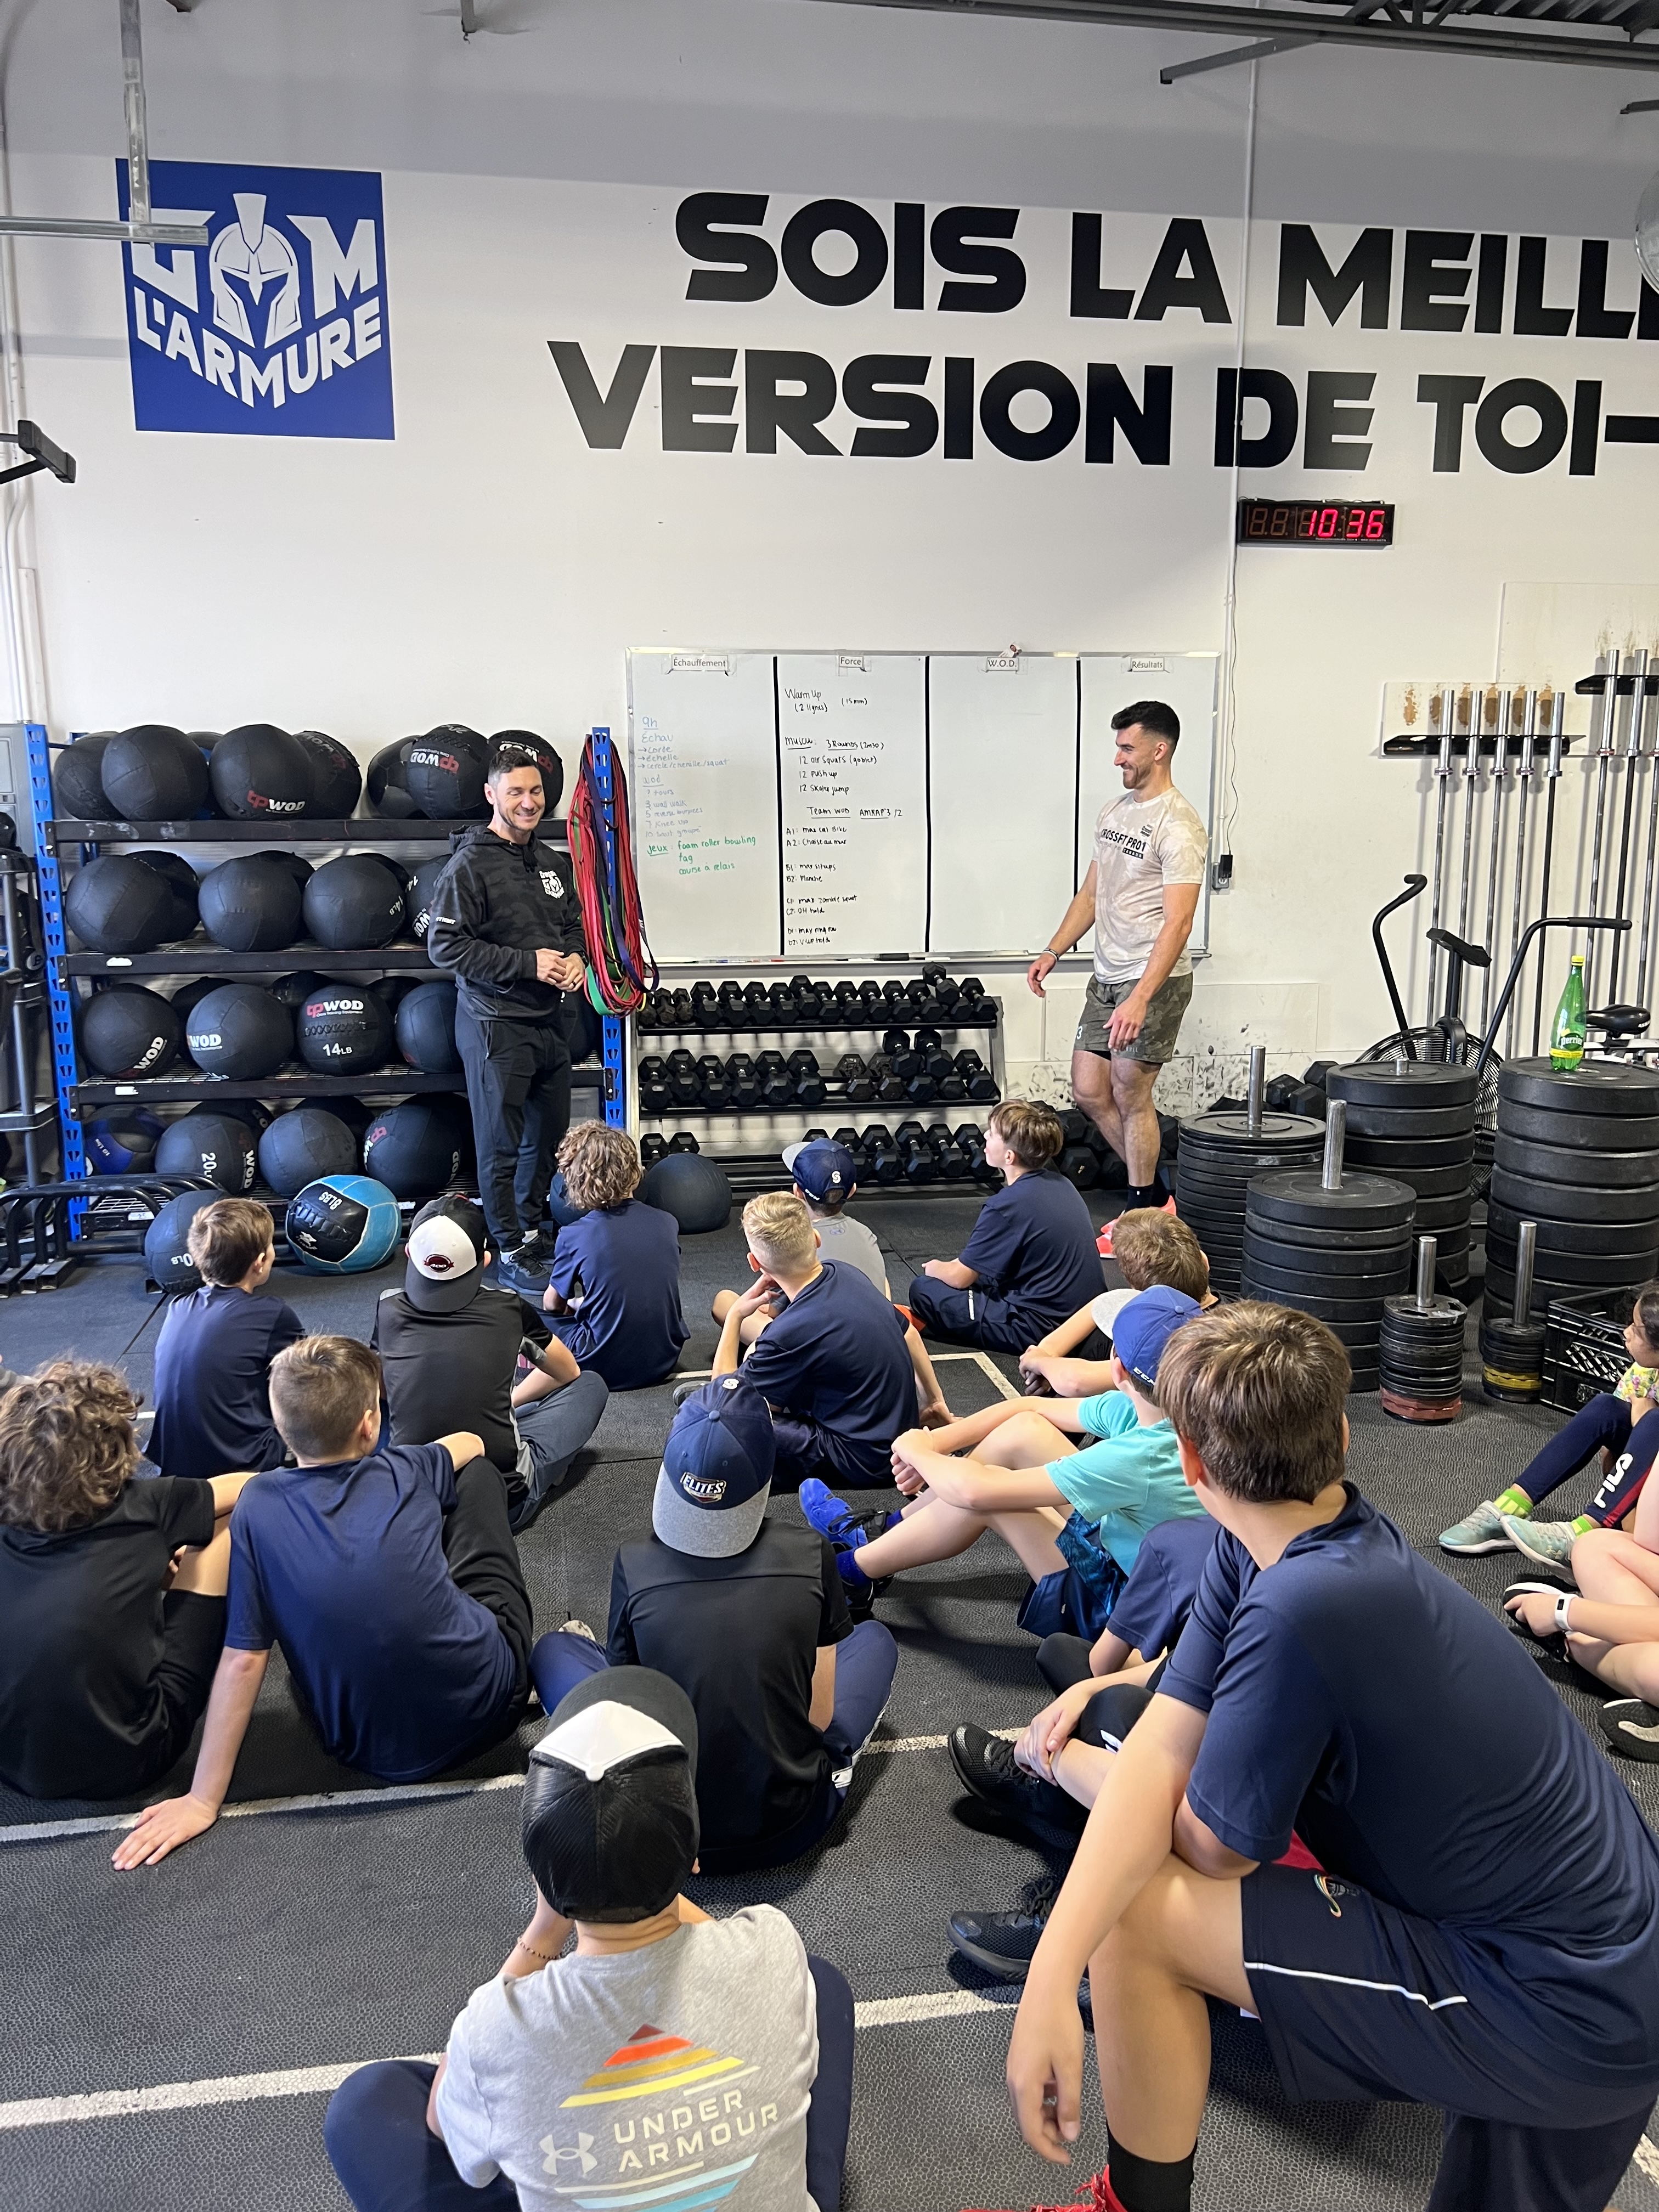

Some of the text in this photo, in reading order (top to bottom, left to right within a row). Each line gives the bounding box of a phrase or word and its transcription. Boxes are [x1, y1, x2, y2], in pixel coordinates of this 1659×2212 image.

[675, 191, 1026, 313] SOIS
[1070, 211, 1232, 324] LA
[133, 286, 382, 408] L'ARMURE
[547, 340, 1173, 465] VERSION
[1214, 366, 1377, 471] DE
[674, 657, 726, 667] Échauffement
[840, 657, 861, 665] Force
[988, 659, 1017, 668] W.O.D.
[799, 755, 808, 765] 12
[799, 770, 807, 778] 12
[799, 784, 807, 792] 12
[678, 840, 698, 850] foam
[701, 838, 720, 847] roller
[724, 835, 756, 846] bowling
[679, 852, 693, 864] tag
[679, 866, 702, 875] course
[714, 861, 735, 871] relais
[133, 1036, 165, 1070] WOD
[323, 1043, 353, 1057] 14LB
[318, 1191, 343, 1210] 8LBS
[683, 1474, 724, 1494] ELITES
[1593, 1452, 1634, 1509] FILA
[613, 2088, 743, 2145] UNDER
[618, 2102, 779, 2173] ARMOUR
